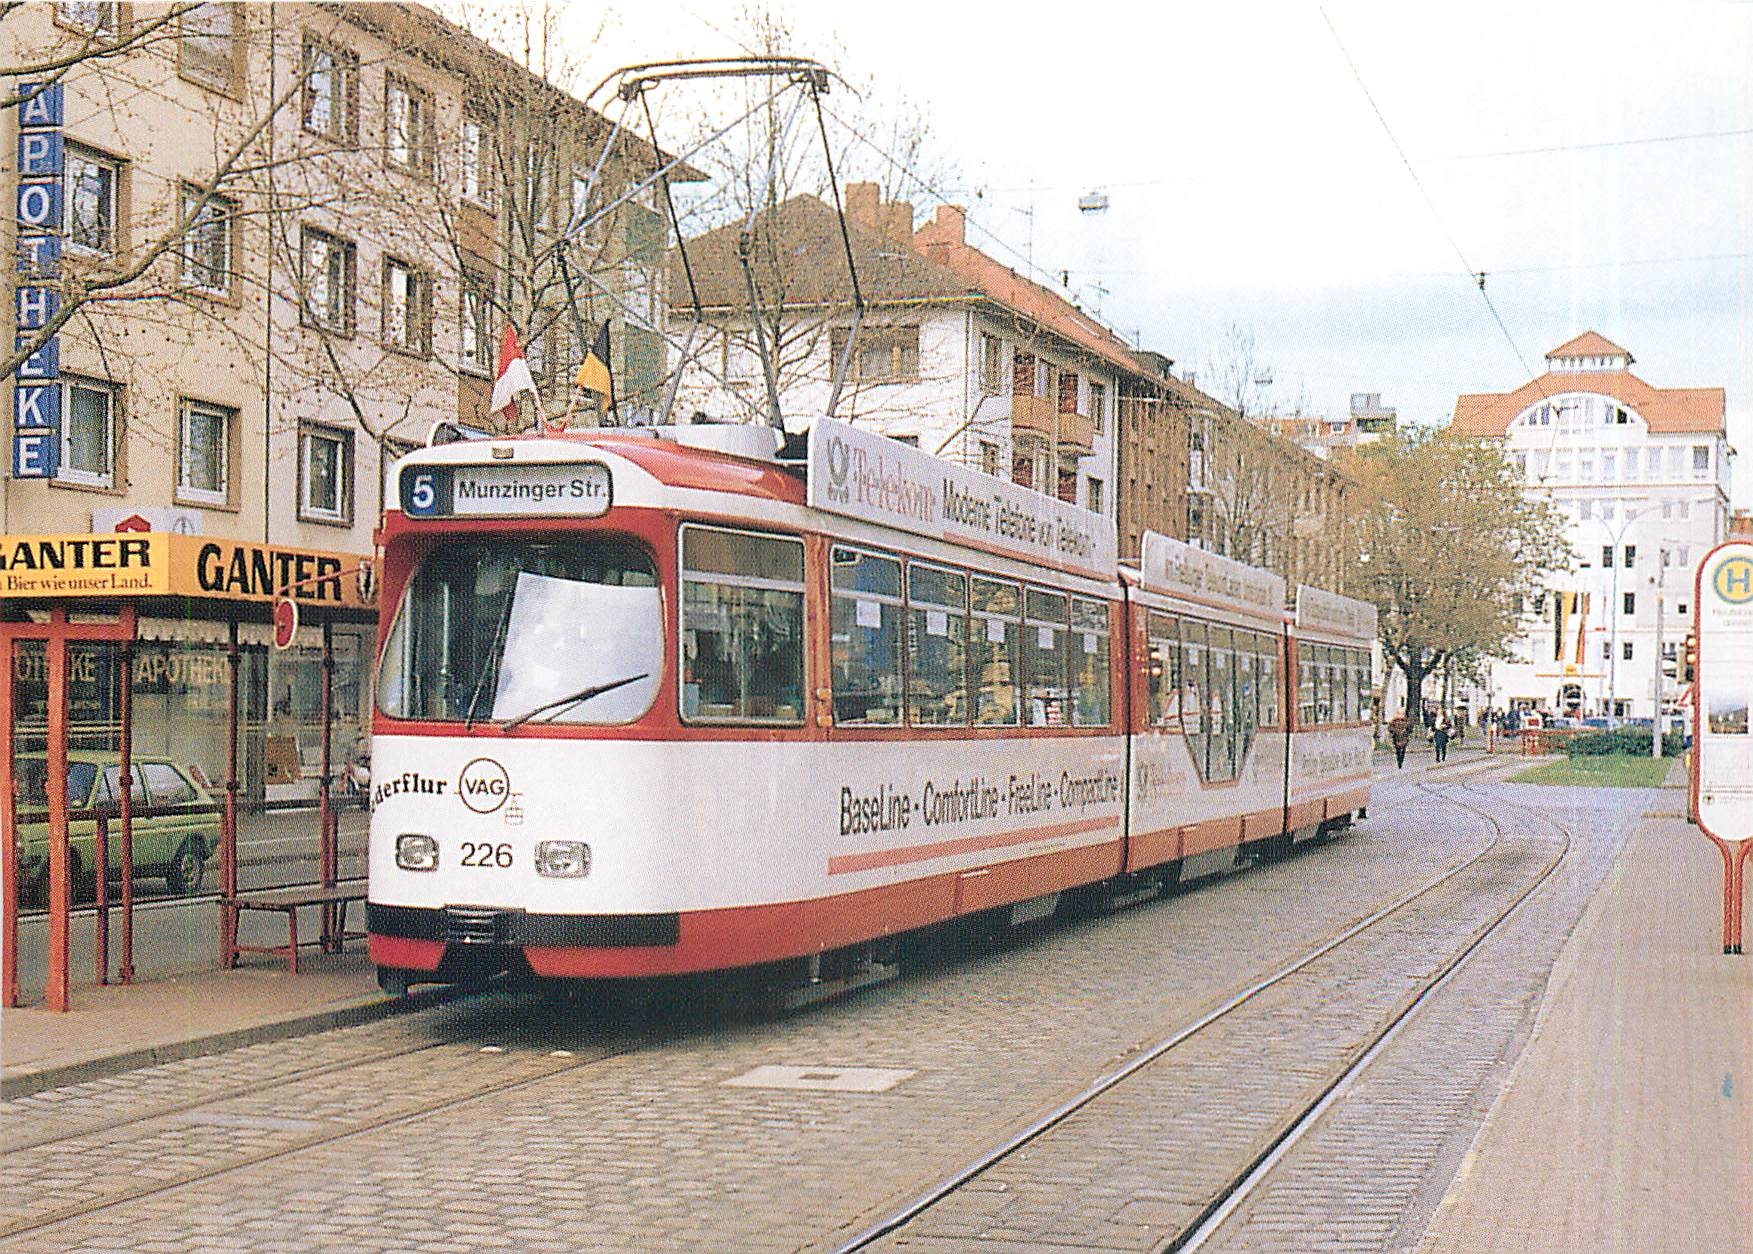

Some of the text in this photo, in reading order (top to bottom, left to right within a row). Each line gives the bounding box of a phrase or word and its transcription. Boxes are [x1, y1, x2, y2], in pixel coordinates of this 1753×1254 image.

[411, 475, 436, 509] 5
[458, 476, 608, 502] Munzinger Str.
[0, 539, 150, 570] ANTER
[7, 572, 153, 591] Bier wie unser Land.
[196, 542, 342, 602] GANTER
[1726, 567, 1750, 593] H
[464, 777, 506, 796] VAG
[840, 784, 910, 836] BaseLine
[922, 779, 998, 826] ComfortLine
[460, 841, 514, 869] 226
